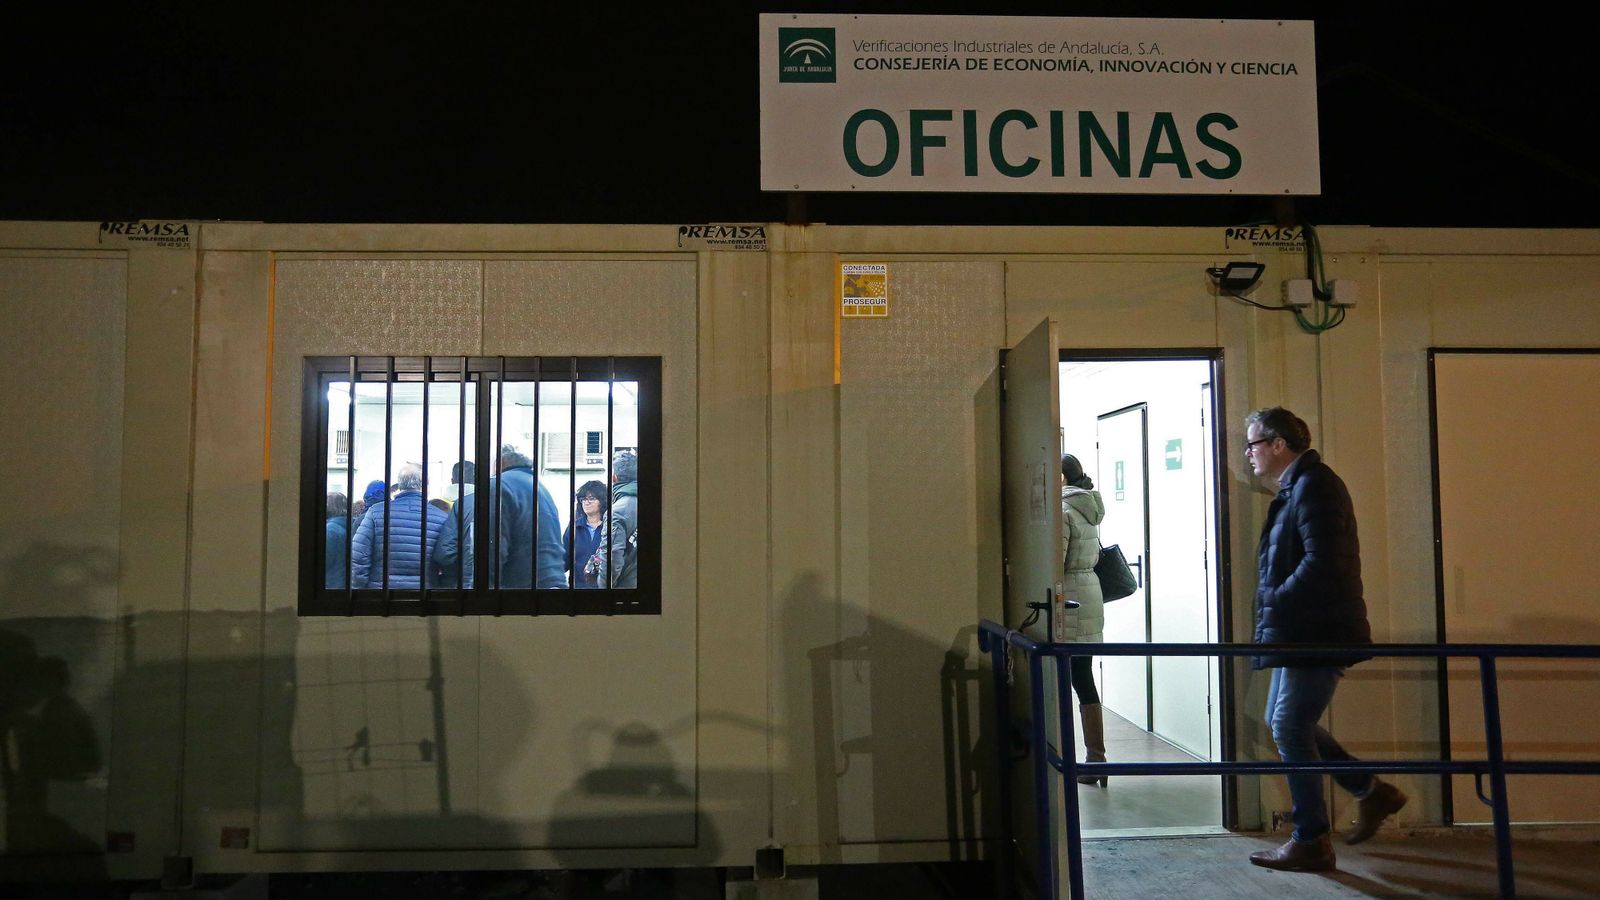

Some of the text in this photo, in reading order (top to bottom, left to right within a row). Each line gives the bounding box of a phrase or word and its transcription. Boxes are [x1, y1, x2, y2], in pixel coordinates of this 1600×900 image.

[853, 39, 1164, 56] Verificaciones Industriales de Andalucía, S.A.
[853, 55, 1298, 76] CONSEJERÍA DE ECONOMÍA, INNOVACIÓN Y CIENCIA
[843, 108, 1242, 180] OFICINAS
[108, 222, 189, 236] REMSA
[687, 225, 767, 239] REMSA
